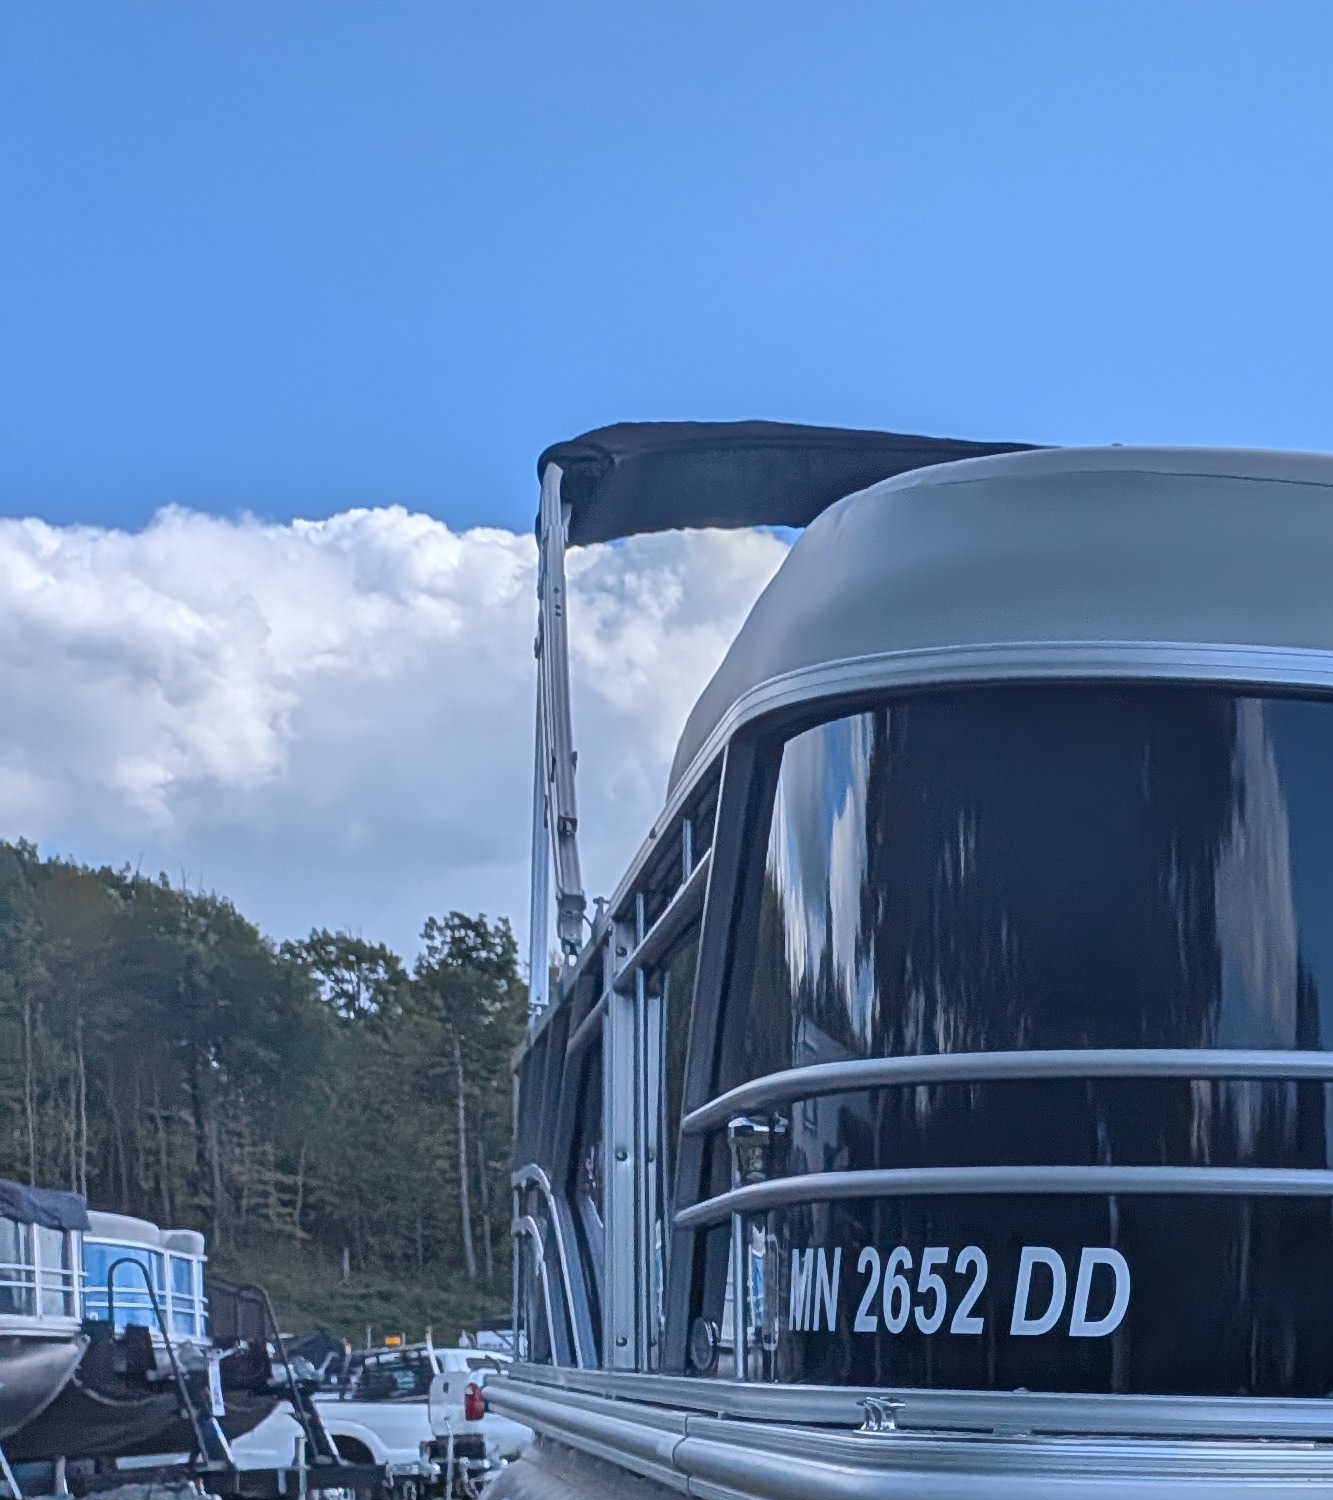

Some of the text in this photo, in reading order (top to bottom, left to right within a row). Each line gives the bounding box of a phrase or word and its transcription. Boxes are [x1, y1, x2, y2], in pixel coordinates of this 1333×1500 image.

[788, 1245, 1132, 1338] MN 2652 DD
